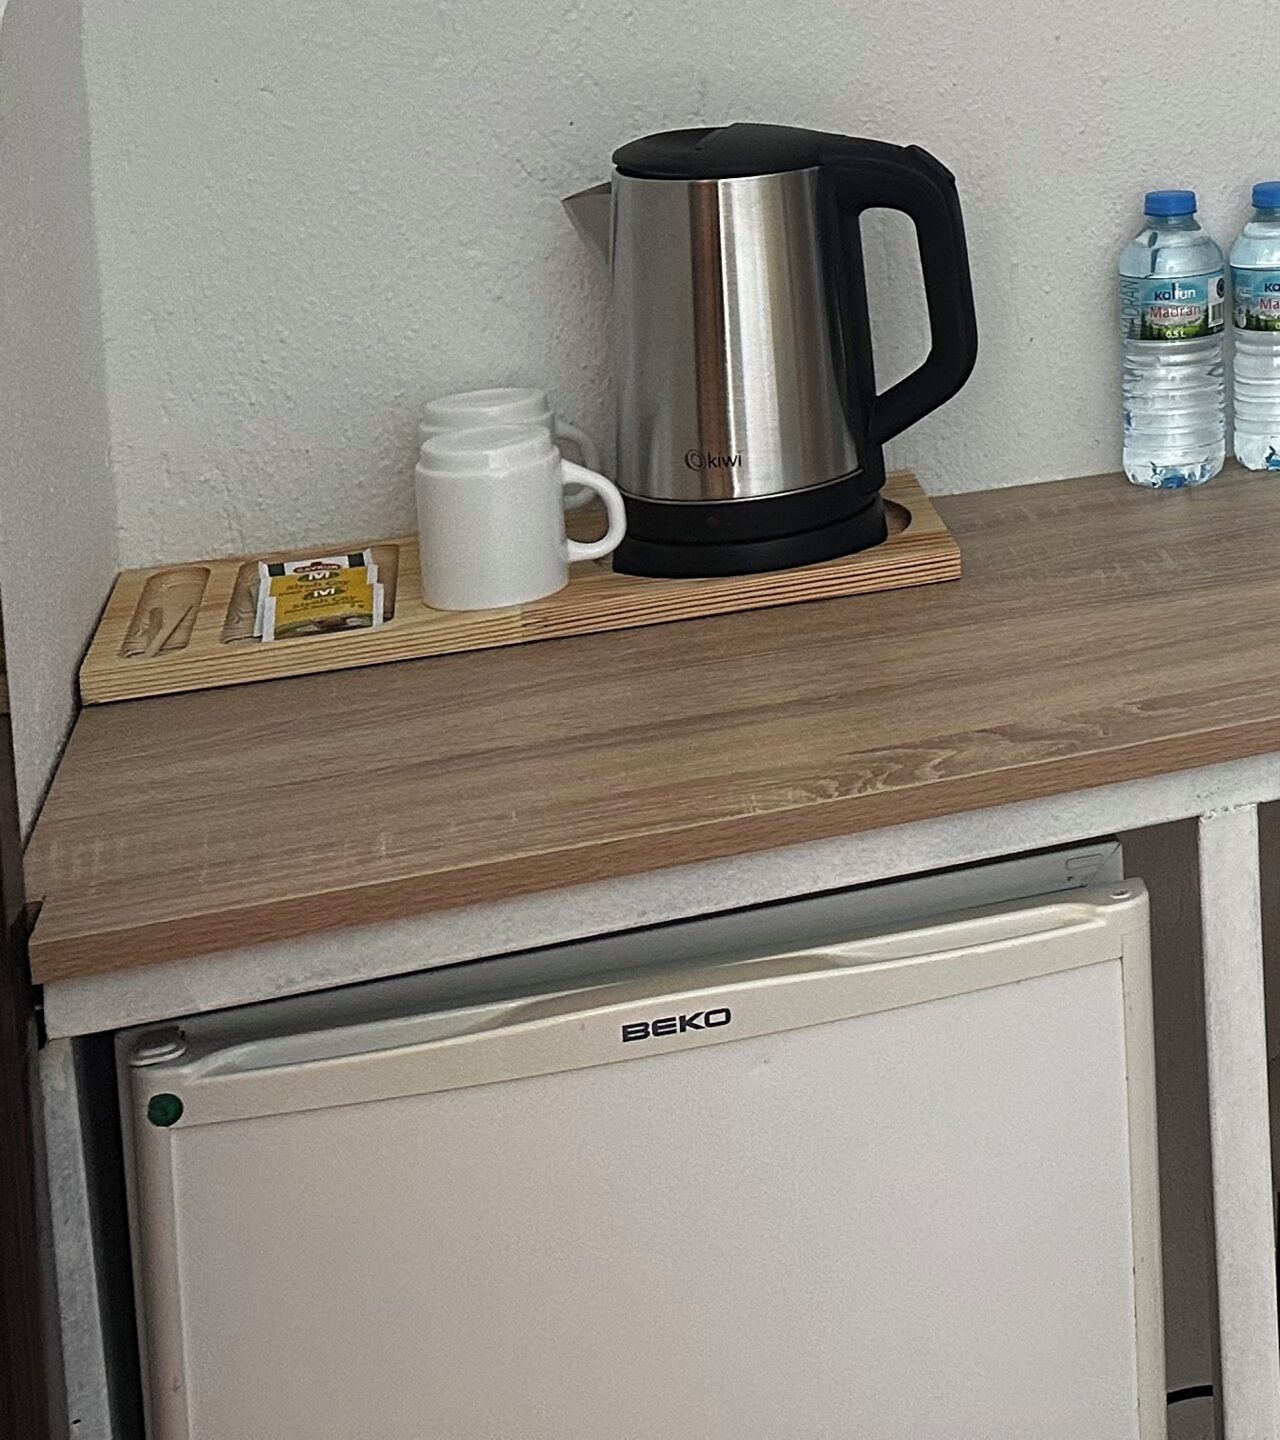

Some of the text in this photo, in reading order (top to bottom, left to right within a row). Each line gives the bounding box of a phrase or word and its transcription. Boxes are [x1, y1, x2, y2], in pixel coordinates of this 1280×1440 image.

[1150, 305, 1200, 319] Madran
[707, 450, 743, 469] kiwi
[622, 1008, 731, 1042] BEKO
